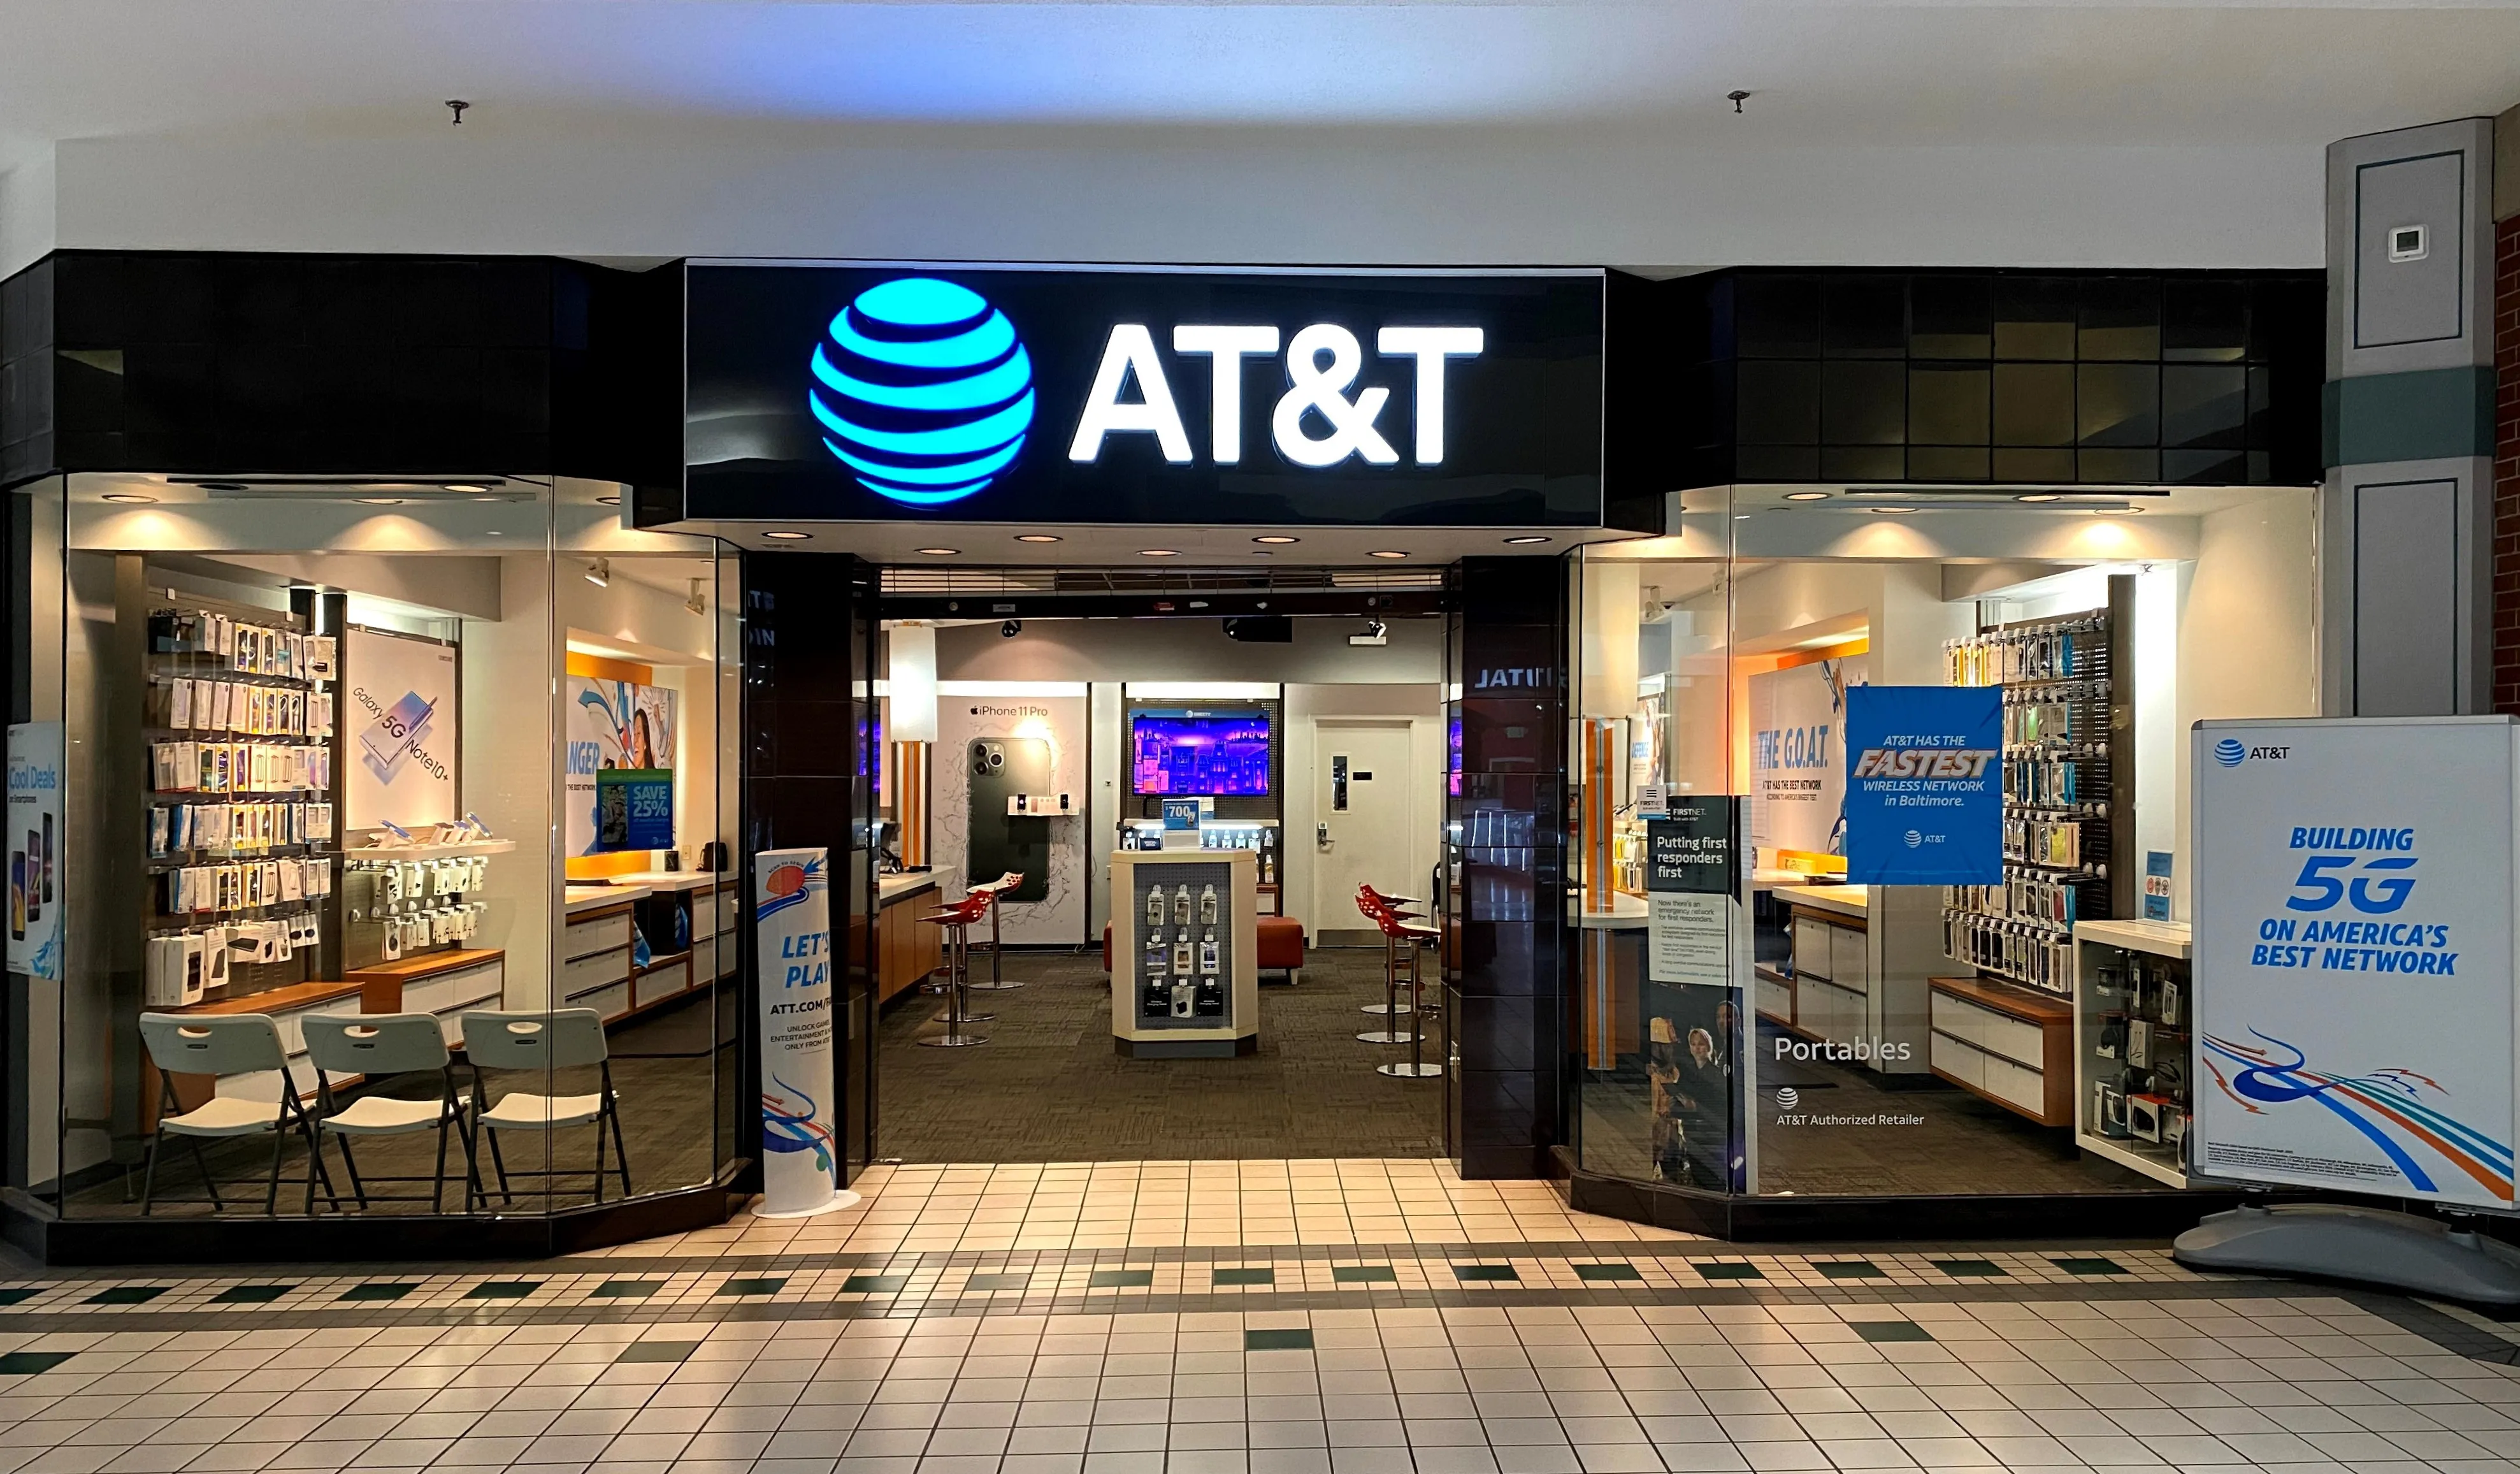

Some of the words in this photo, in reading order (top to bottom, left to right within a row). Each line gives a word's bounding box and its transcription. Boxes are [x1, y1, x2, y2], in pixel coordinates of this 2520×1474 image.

[1068, 322, 1484, 468] AT&T
[979, 706, 1016, 716] iPhone
[1019, 707, 1027, 716] 11
[1030, 707, 1048, 716] Pro
[353, 687, 383, 719] Galaxy
[382, 715, 407, 739] 5G
[405, 739, 449, 782] Note10+
[1883, 735, 1914, 746] AT&T
[1915, 735, 1940, 746] HAS
[1943, 735, 1966, 746] THE
[1758, 730, 1780, 769] THE
[1784, 725, 1828, 769] G.O.A.T.
[2249, 747, 2291, 760] AT&T
[566, 741, 600, 774] NGER
[1852, 748, 1999, 779] FASTEST
[31, 763, 55, 789] Deals
[1789, 780, 1799, 790] BEST
[1800, 780, 1822, 790] NETWORK
[1863, 781, 1921, 791] WIRELESS
[1922, 781, 1985, 791] NETWORK
[633, 786, 667, 800] SAVE
[1884, 795, 1896, 806] in
[1899, 795, 1964, 806] Baltimore.
[633, 800, 668, 817] 25%
[1657, 836, 1699, 851] Putting
[1702, 837, 1727, 849] first
[1924, 835, 1946, 843] AT&T
[2289, 827, 2414, 850] BUILDING
[1657, 851, 1723, 865] responders
[1657, 865, 1682, 878] first
[2286, 855, 2419, 914] 5G
[2259, 918, 2297, 941] ON
[2301, 921, 2449, 948] AMERICA'S
[2251, 944, 2317, 968] BEST
[2322, 948, 2459, 976] NETWORK
[787, 1023, 815, 1032] UNLOCK
[770, 1030, 824, 1043] ENTERTAINMENT
[805, 1039, 822, 1048] FROM
[1775, 1036, 1911, 1060] Portables
[1776, 1115, 1807, 1125] AT&T
[1810, 1115, 1875, 1125] Authorized
[1878, 1115, 1925, 1125] Retailer
